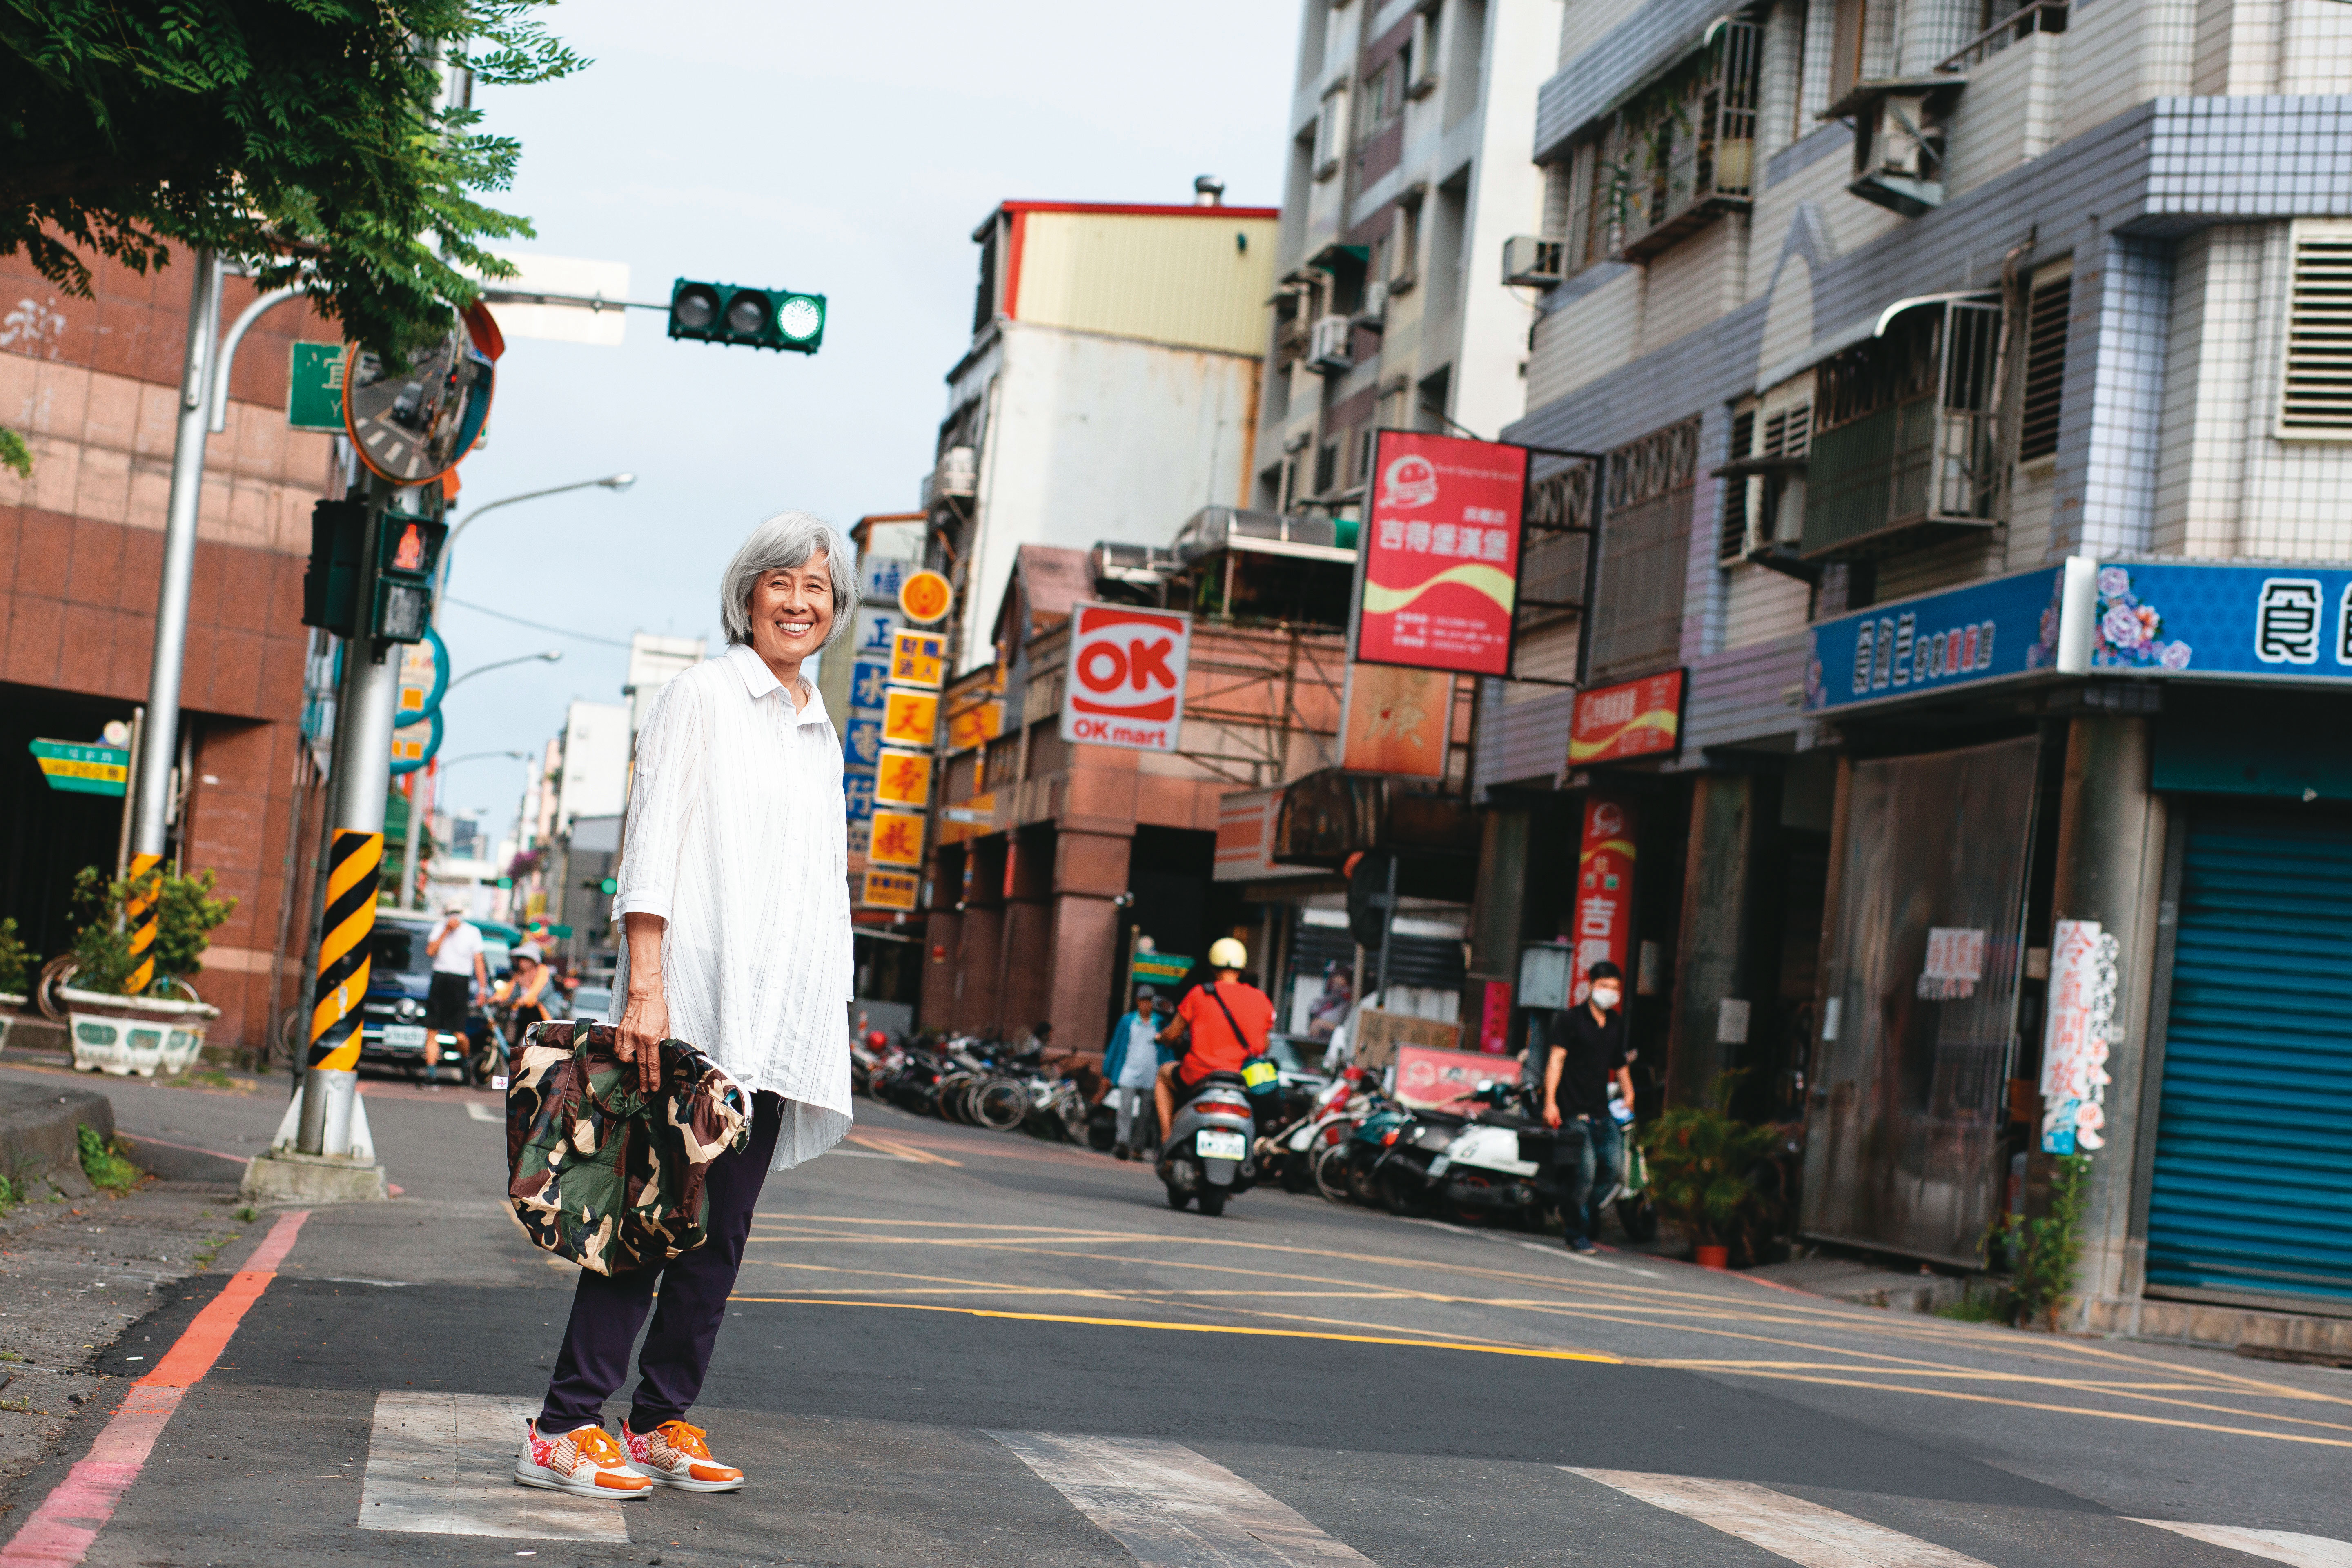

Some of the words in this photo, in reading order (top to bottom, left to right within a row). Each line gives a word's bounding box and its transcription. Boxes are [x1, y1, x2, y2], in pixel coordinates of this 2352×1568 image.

[2255, 577, 2352, 666] 食
[1076, 637, 1177, 693] OK
[1073, 718, 1108, 740] OK
[1112, 726, 1167, 748] mart
[2047, 922, 2093, 1097] 冷氣開放
